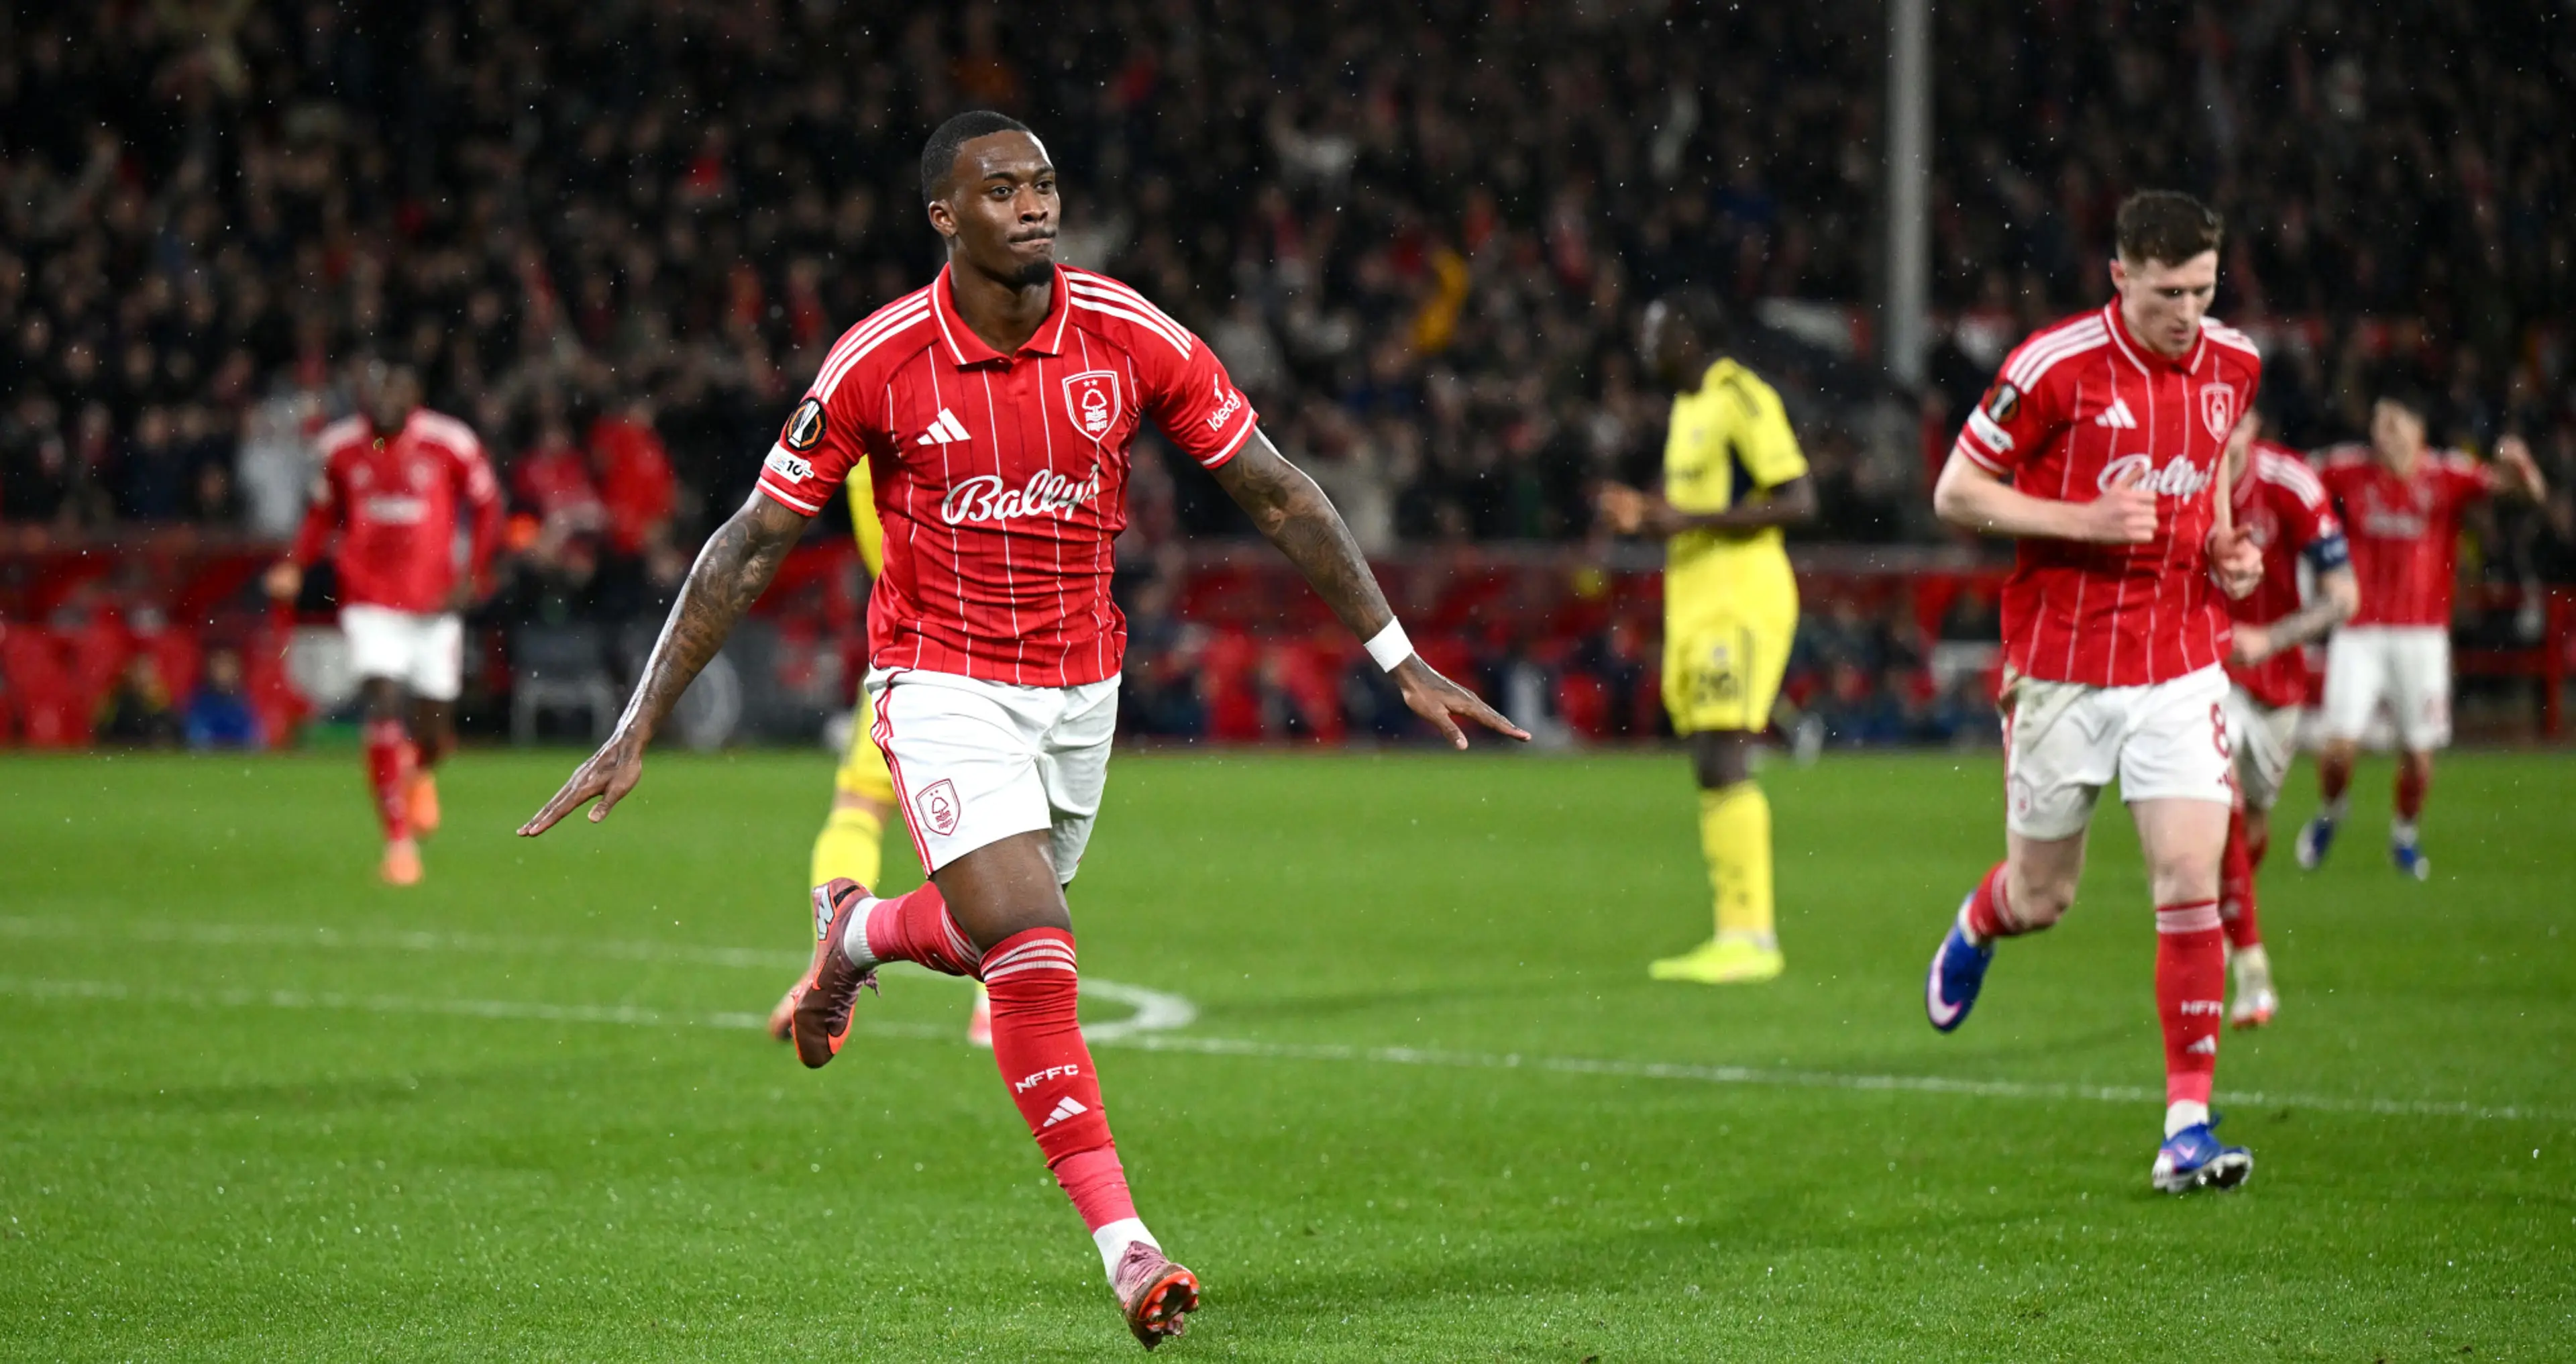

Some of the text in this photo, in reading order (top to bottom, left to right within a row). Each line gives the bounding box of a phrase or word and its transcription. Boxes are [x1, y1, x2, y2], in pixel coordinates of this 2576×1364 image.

[941, 463, 1100, 525] Bally's
[2210, 702, 2229, 759] 8
[1015, 1064, 1079, 1094] NFFC
